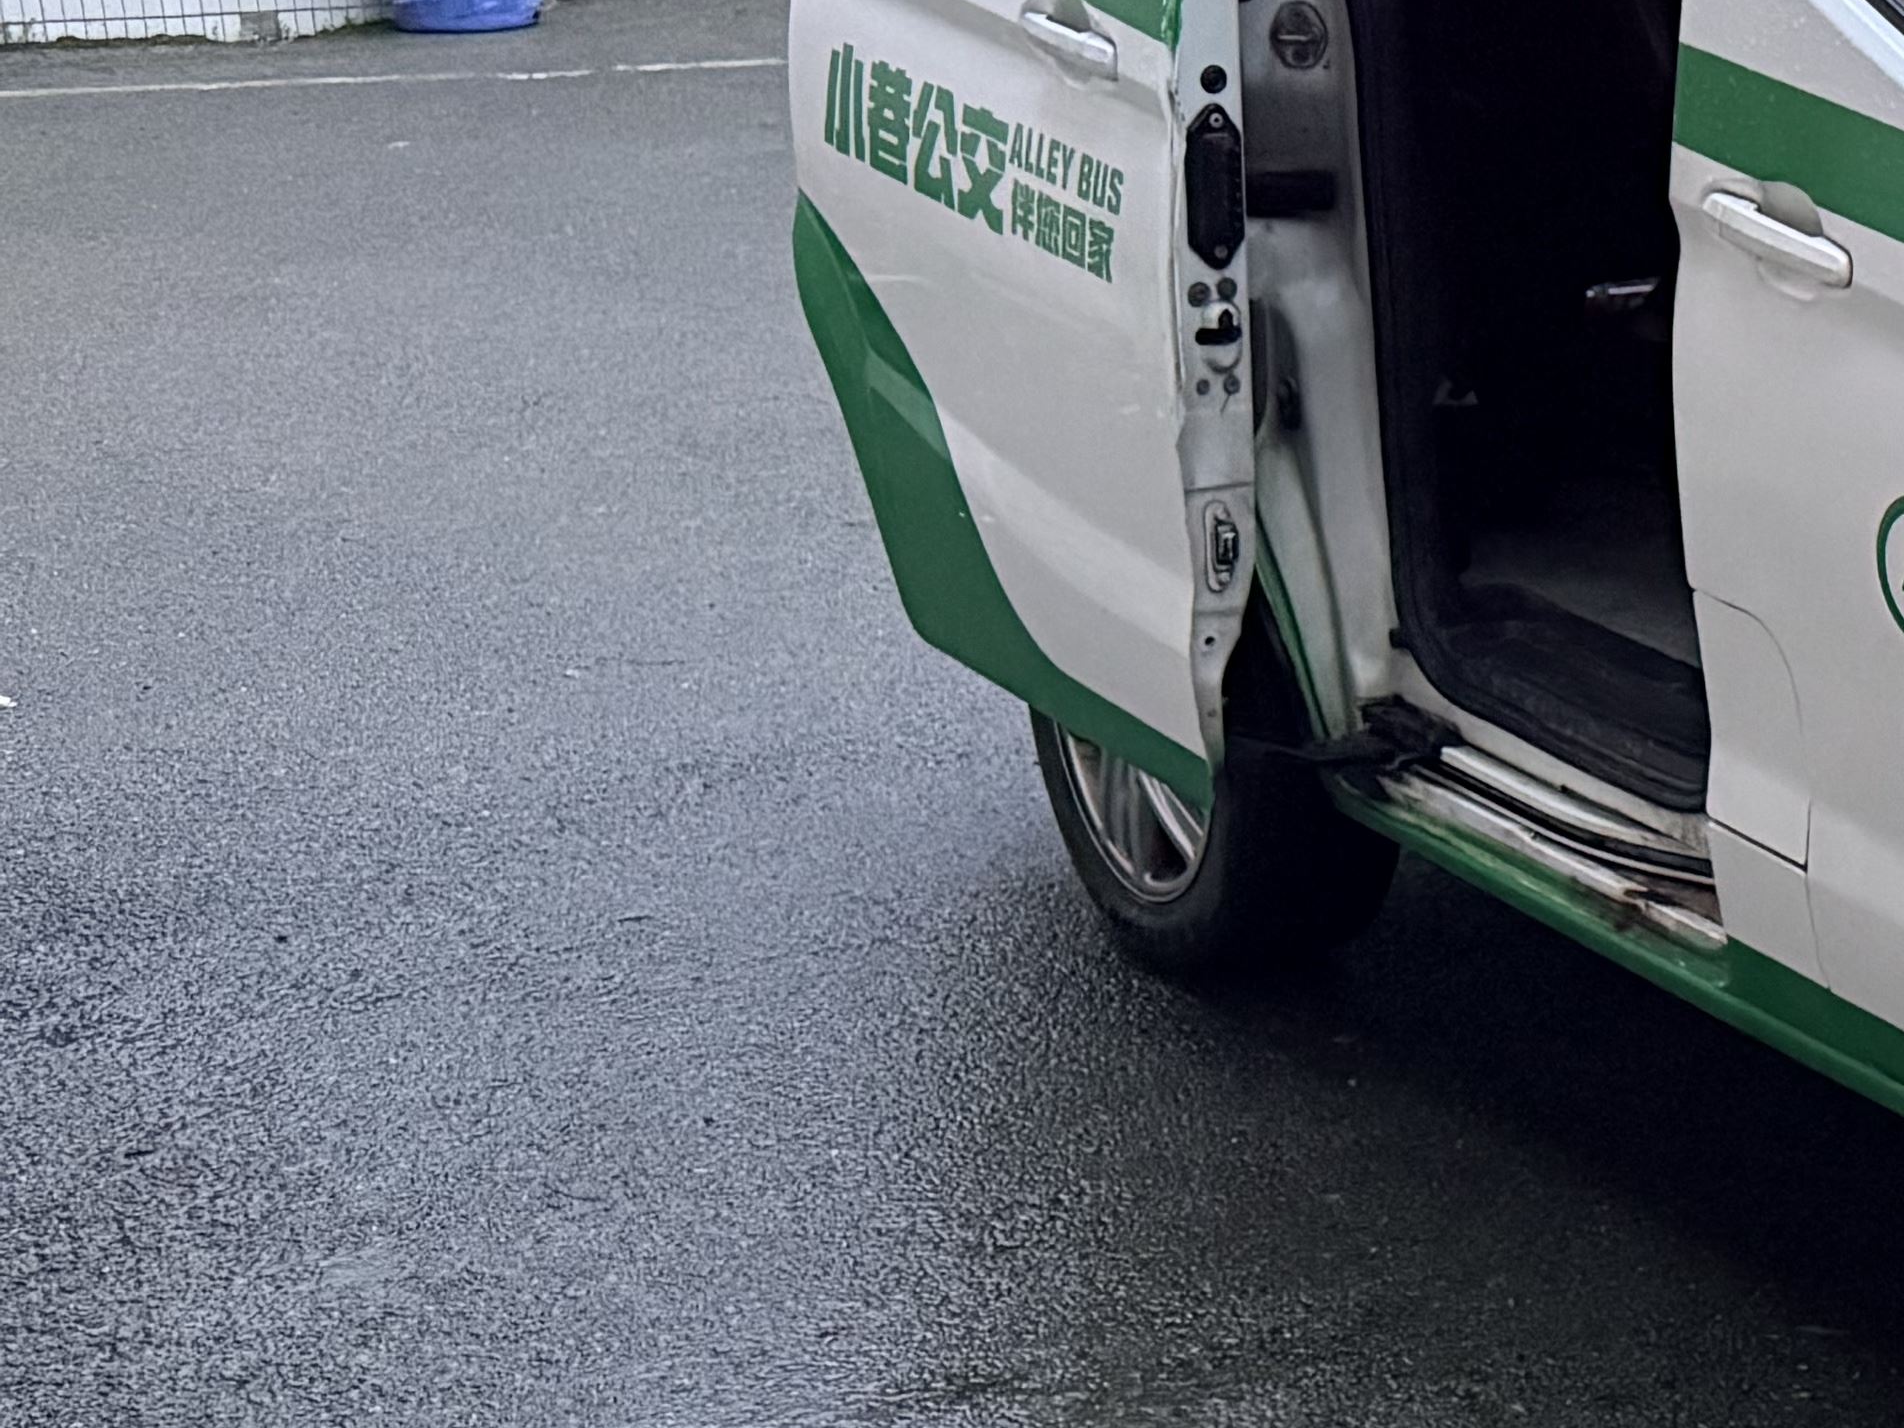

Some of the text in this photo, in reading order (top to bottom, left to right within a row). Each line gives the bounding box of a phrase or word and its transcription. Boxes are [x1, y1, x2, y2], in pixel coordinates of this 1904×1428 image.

[824, 42, 1009, 235] 小巷公交
[1009, 123, 1124, 216] ALLEY BUS
[1011, 178, 1115, 283] 伴您回家
